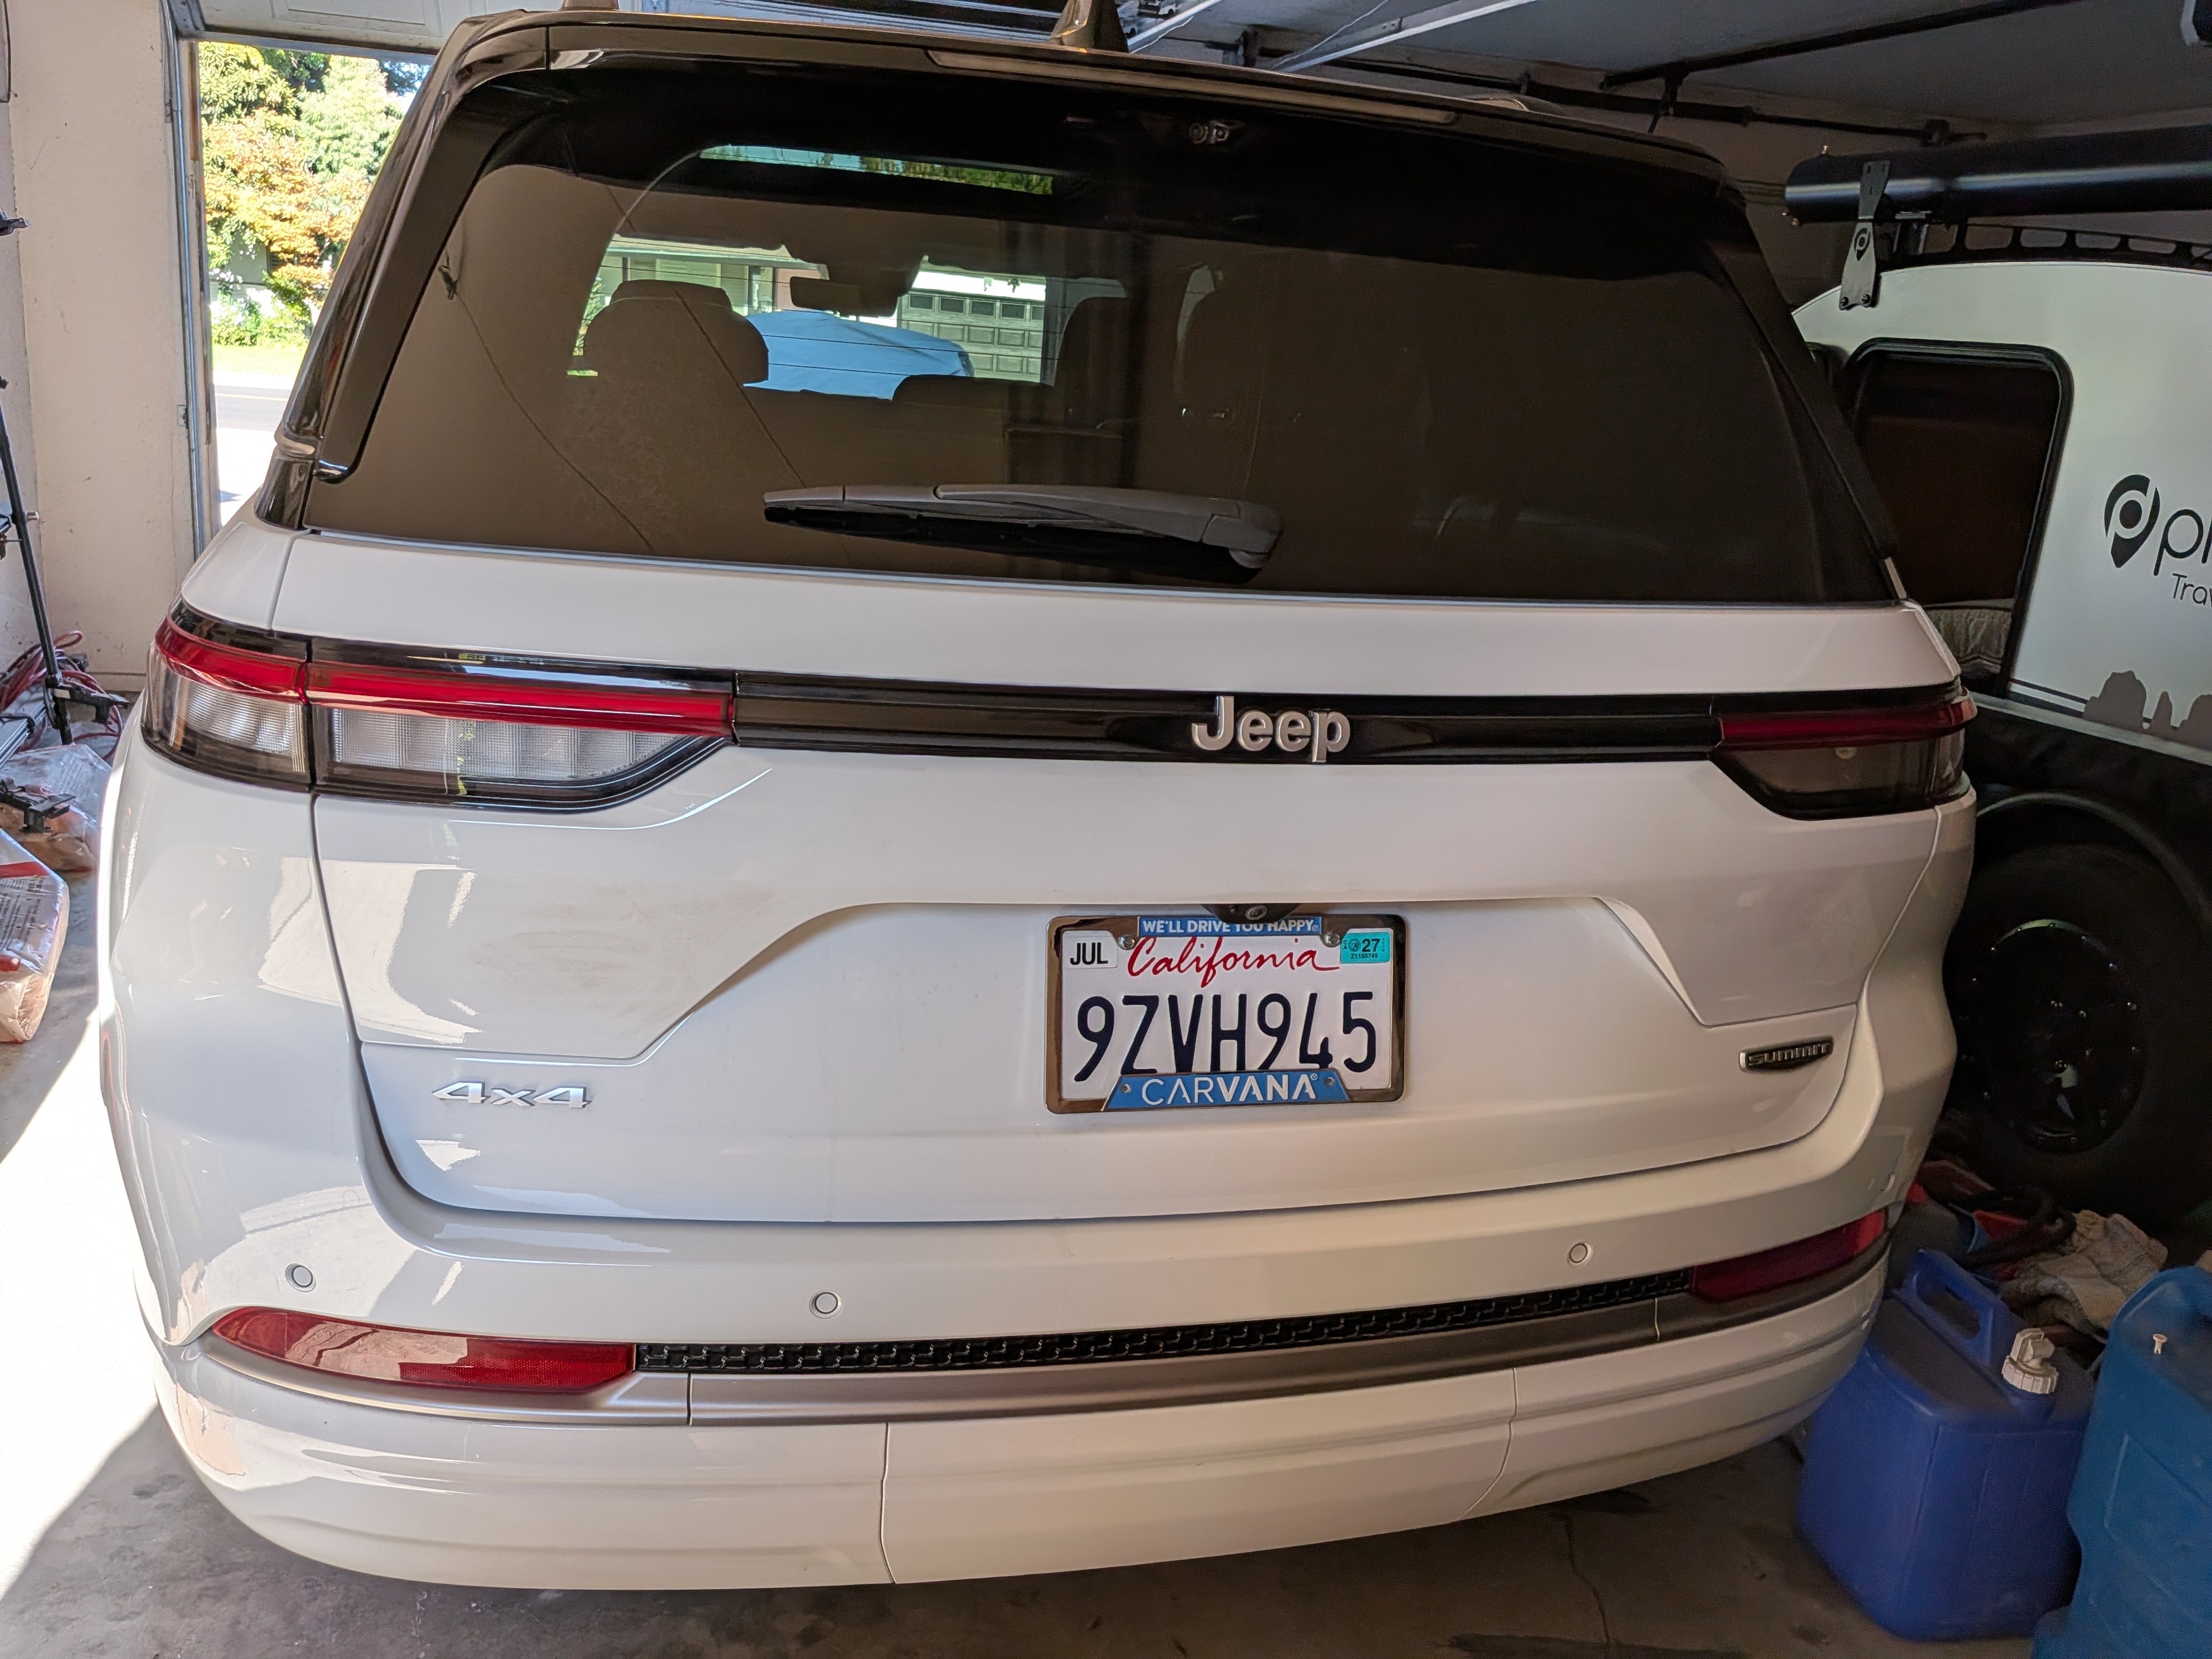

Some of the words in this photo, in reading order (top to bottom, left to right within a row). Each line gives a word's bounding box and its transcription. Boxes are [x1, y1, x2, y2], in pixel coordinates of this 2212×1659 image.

[2172, 573, 2212, 607] Tra
[1191, 696, 1350, 763] Jeep
[1142, 920, 1184, 933] WE'LL
[1188, 920, 1230, 932] DRIVE
[1235, 922, 1264, 932] YOU
[1070, 942, 1109, 966] JUL
[1362, 938, 1380, 952] 27
[1126, 936, 1340, 988] California
[1073, 992, 1376, 1082] 9ZVH945
[431, 1080, 592, 1108] 4x4
[1141, 1074, 1316, 1105] CARVANA
